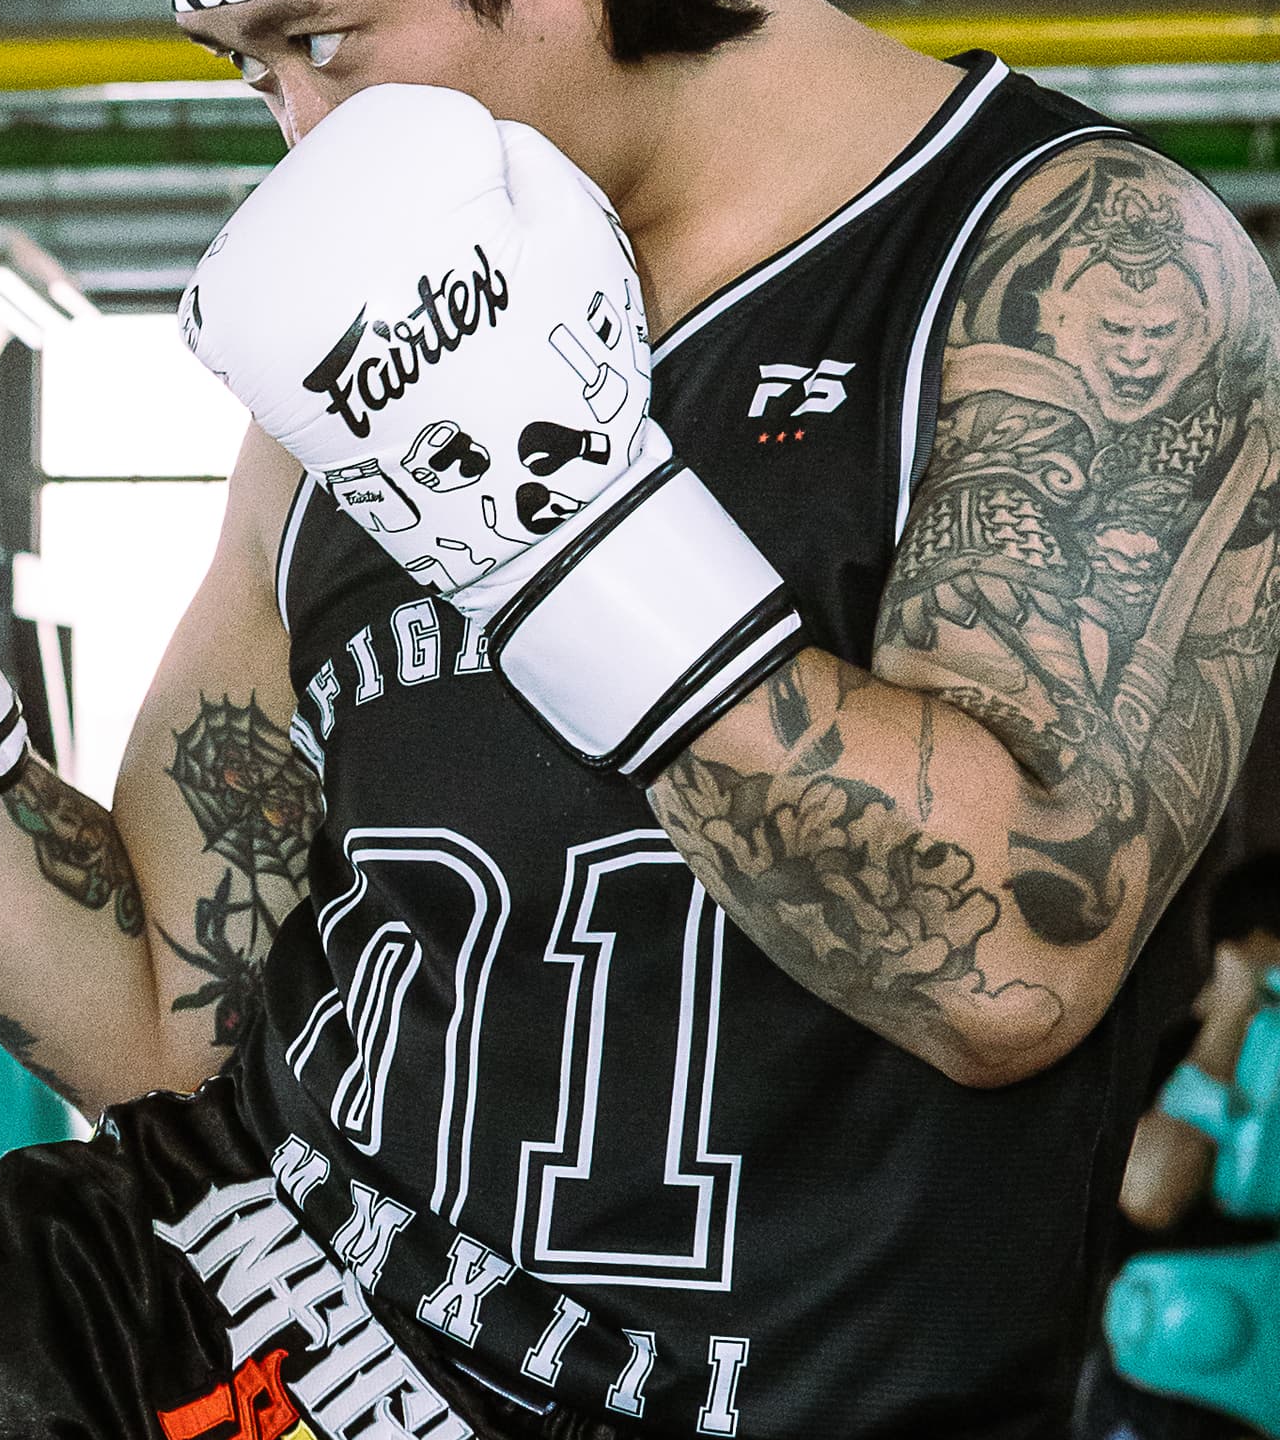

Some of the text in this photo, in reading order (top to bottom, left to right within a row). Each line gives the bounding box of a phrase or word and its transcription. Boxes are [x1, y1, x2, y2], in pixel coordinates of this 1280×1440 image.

[302, 244, 507, 438] Fairtex
[749, 359, 856, 418] FS
[270, 1132, 750, 1438] MMXIII
